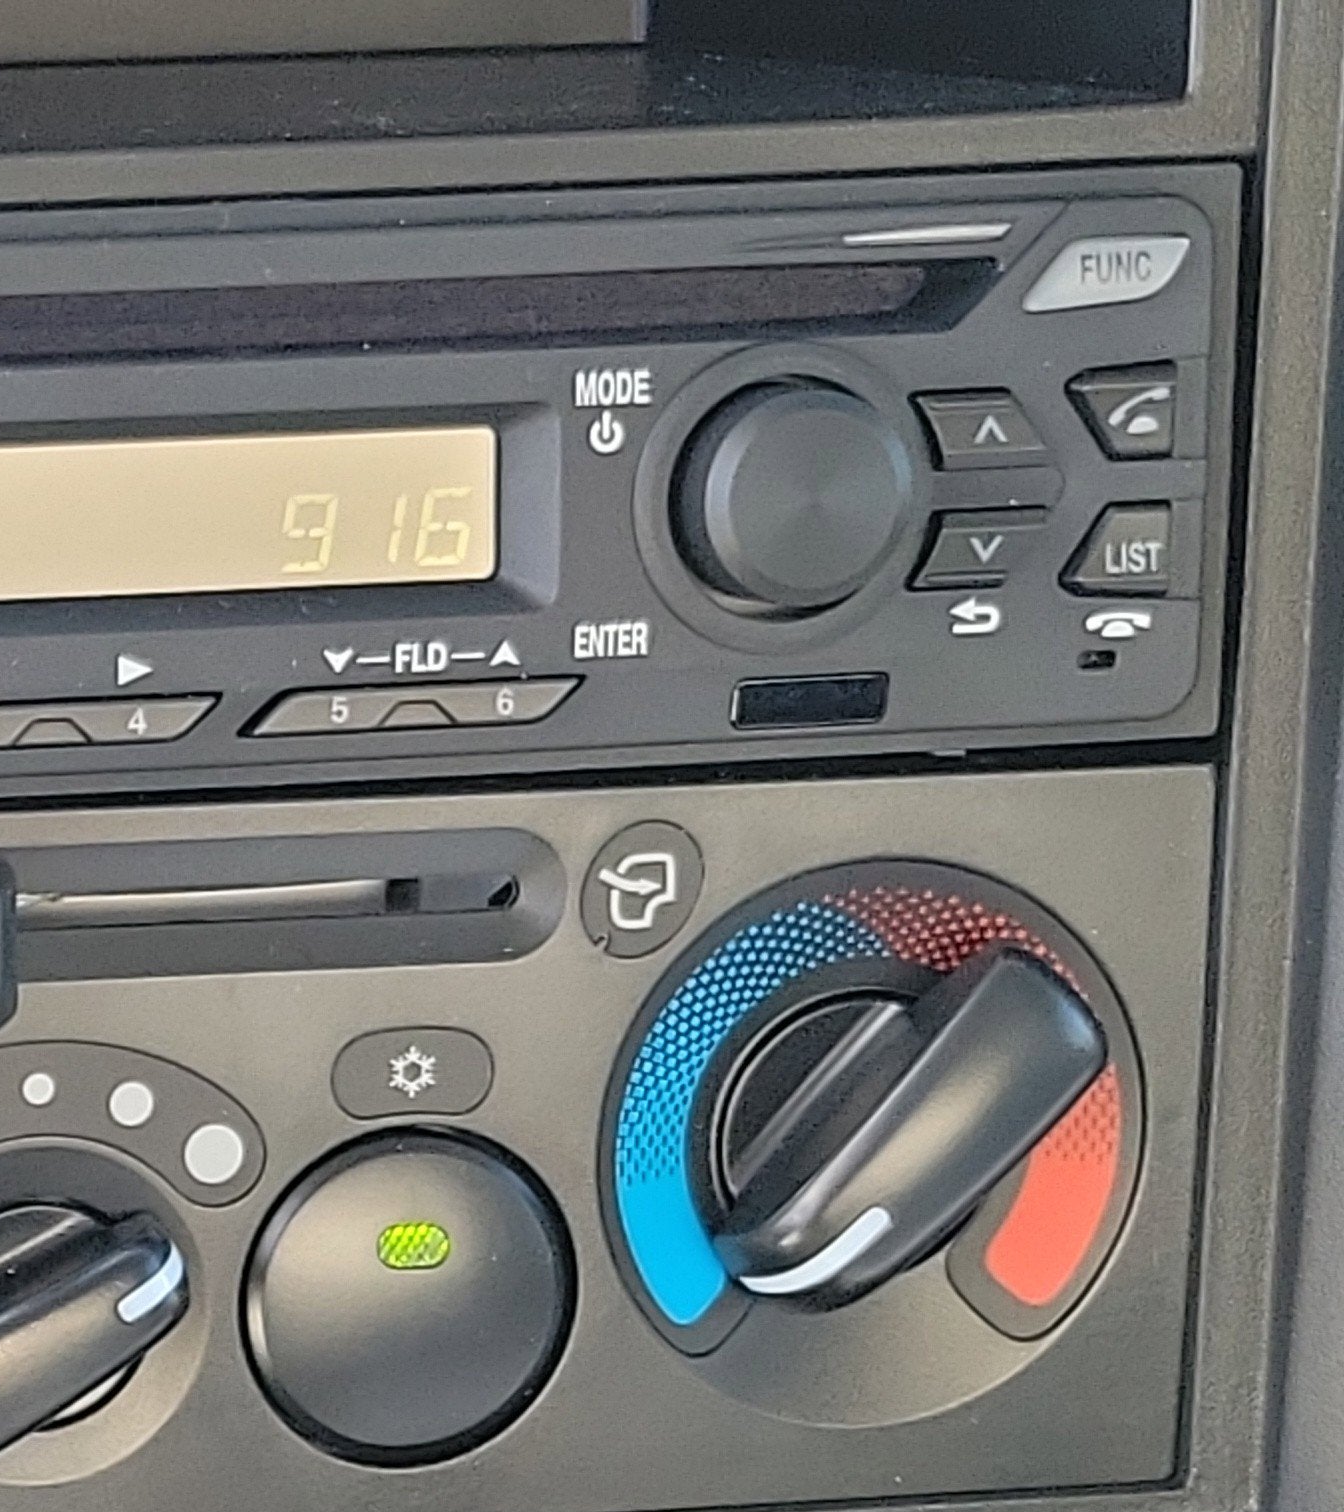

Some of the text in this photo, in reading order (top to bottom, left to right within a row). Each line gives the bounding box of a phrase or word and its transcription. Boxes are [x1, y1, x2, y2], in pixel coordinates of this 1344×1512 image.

[1077, 249, 1152, 286] FUNC
[575, 368, 652, 406] MODE
[1104, 540, 1163, 574] LIST
[573, 621, 649, 659] ENTER
[394, 642, 449, 674] FLD
[329, 695, 350, 723] 5
[495, 687, 516, 715] 6
[126, 706, 149, 736] 4
